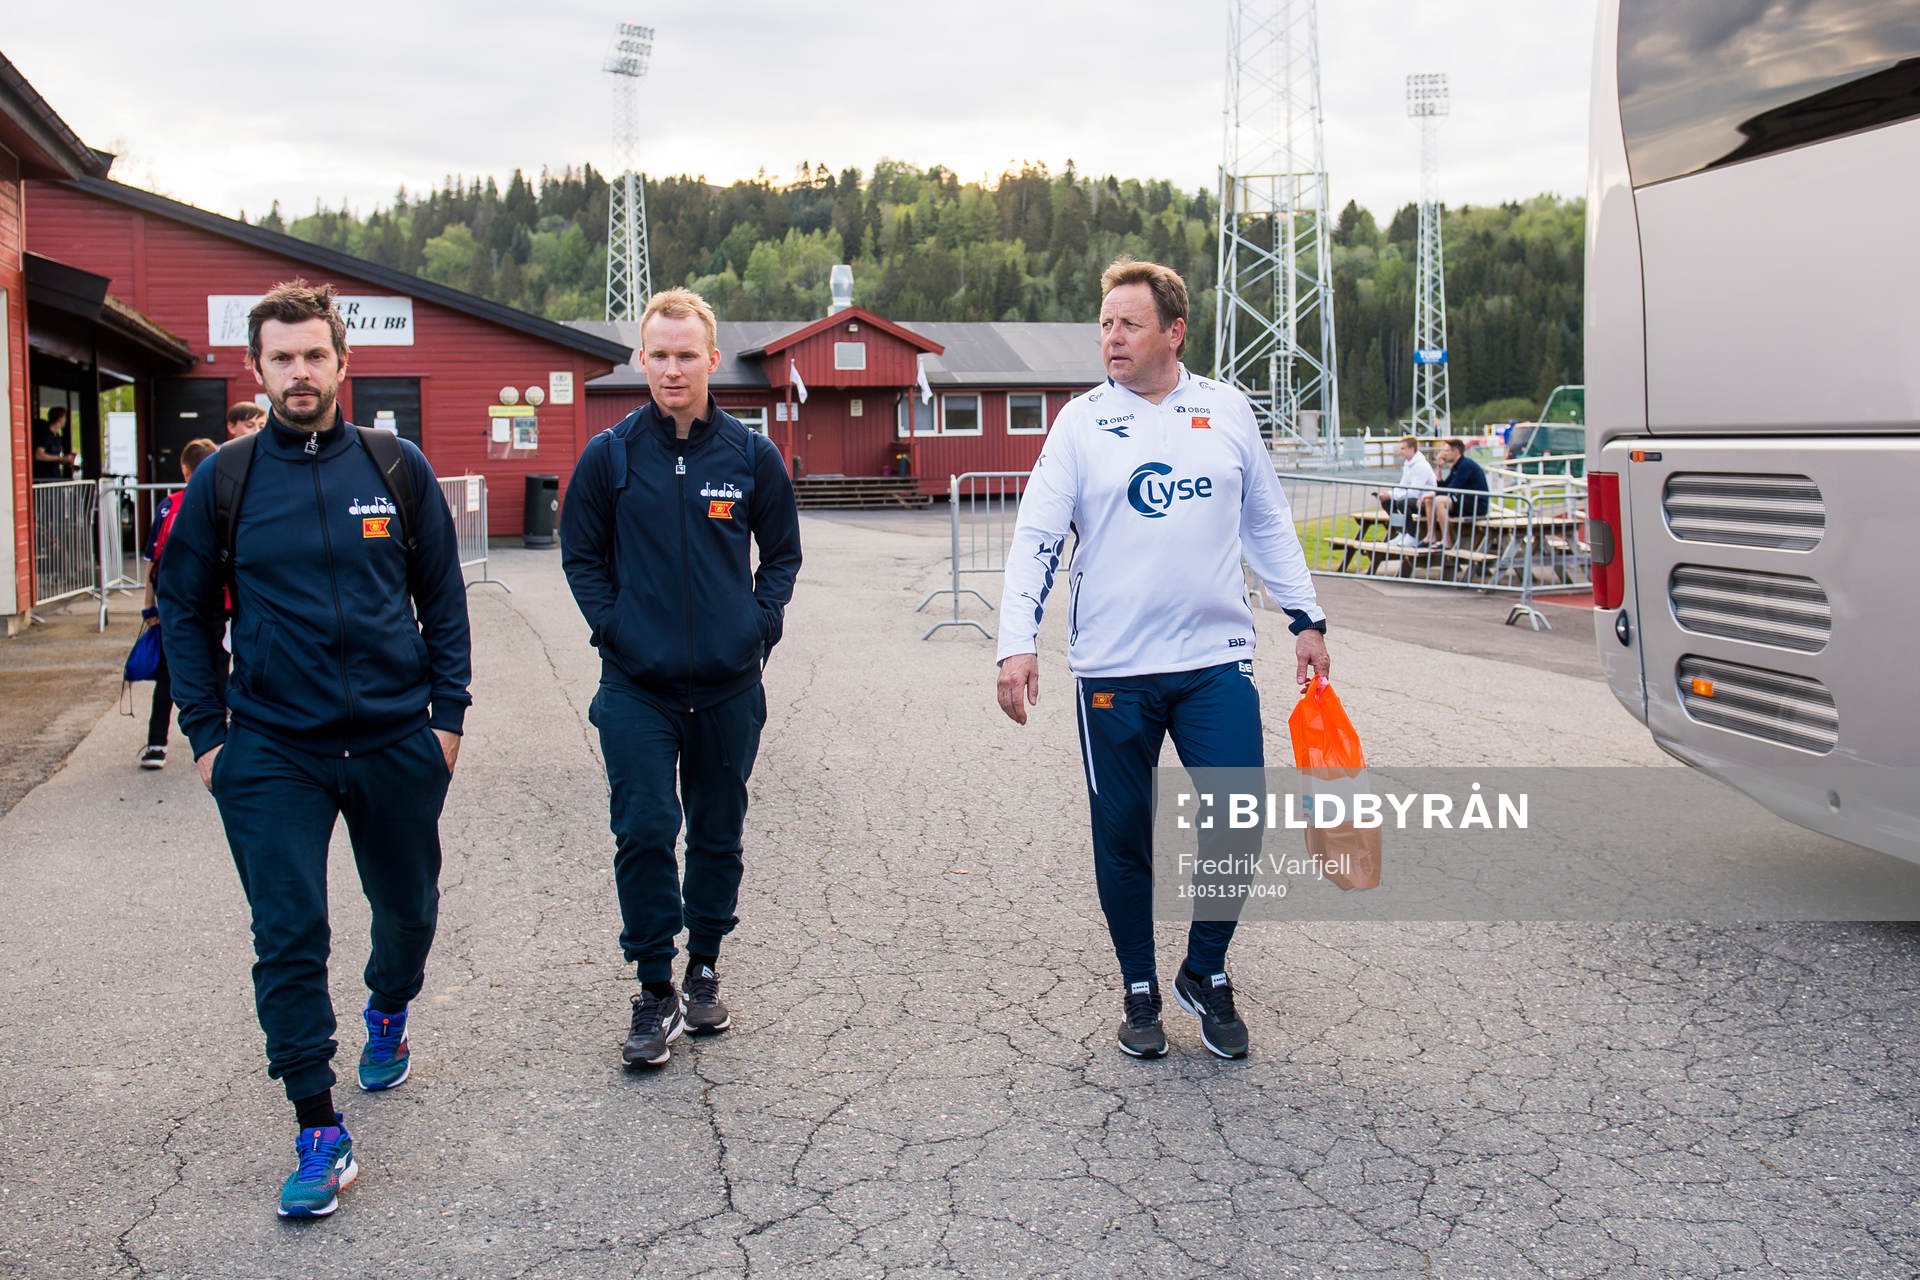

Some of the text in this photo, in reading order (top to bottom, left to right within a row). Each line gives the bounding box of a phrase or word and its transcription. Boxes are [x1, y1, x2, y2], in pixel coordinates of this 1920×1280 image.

[345, 316, 407, 329] KLUBB
[1187, 406, 1211, 414] OBOS
[1109, 413, 1135, 424] OBOS
[700, 481, 743, 499] diadora
[348, 496, 397, 515] diadora
[1228, 637, 1247, 648] BB
